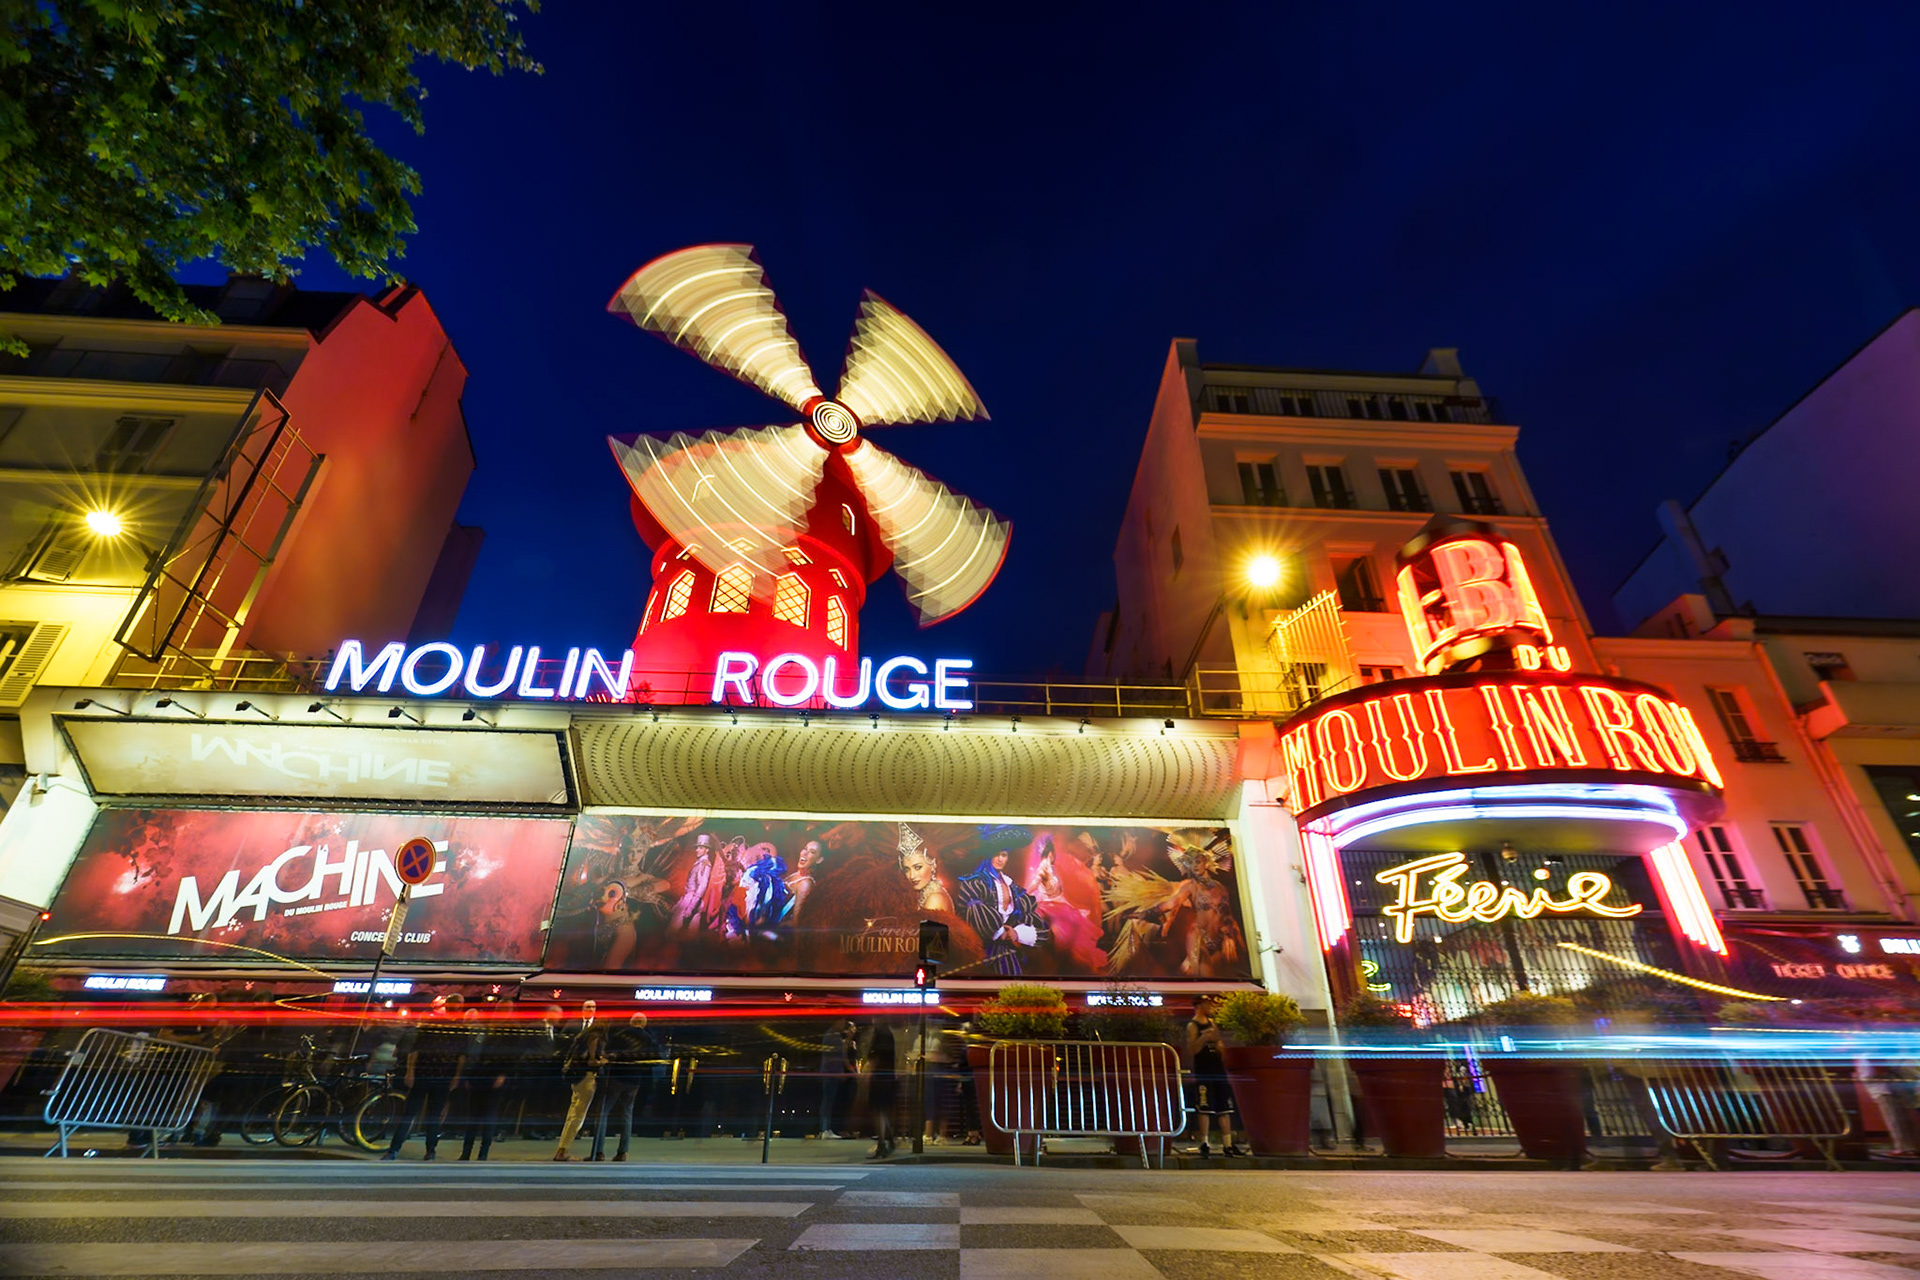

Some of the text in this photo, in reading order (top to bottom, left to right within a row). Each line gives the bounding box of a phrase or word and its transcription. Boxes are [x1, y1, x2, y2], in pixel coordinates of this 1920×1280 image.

[1514, 644, 1571, 671] DU
[325, 640, 974, 710] MOULIN ROUGE
[1280, 685, 1587, 816] MOULIN
[1376, 851, 1643, 943] Féerie
[284, 901, 348, 917] DU MOULIN ROUGE
[350, 930, 431, 944] CONCES CLUB
[840, 934, 892, 954] MOULIN
[1771, 963, 1895, 979] TICKET OFFICE
[635, 989, 712, 1001] MOULIN ROUGE
[863, 993, 902, 1004] MOULIN
